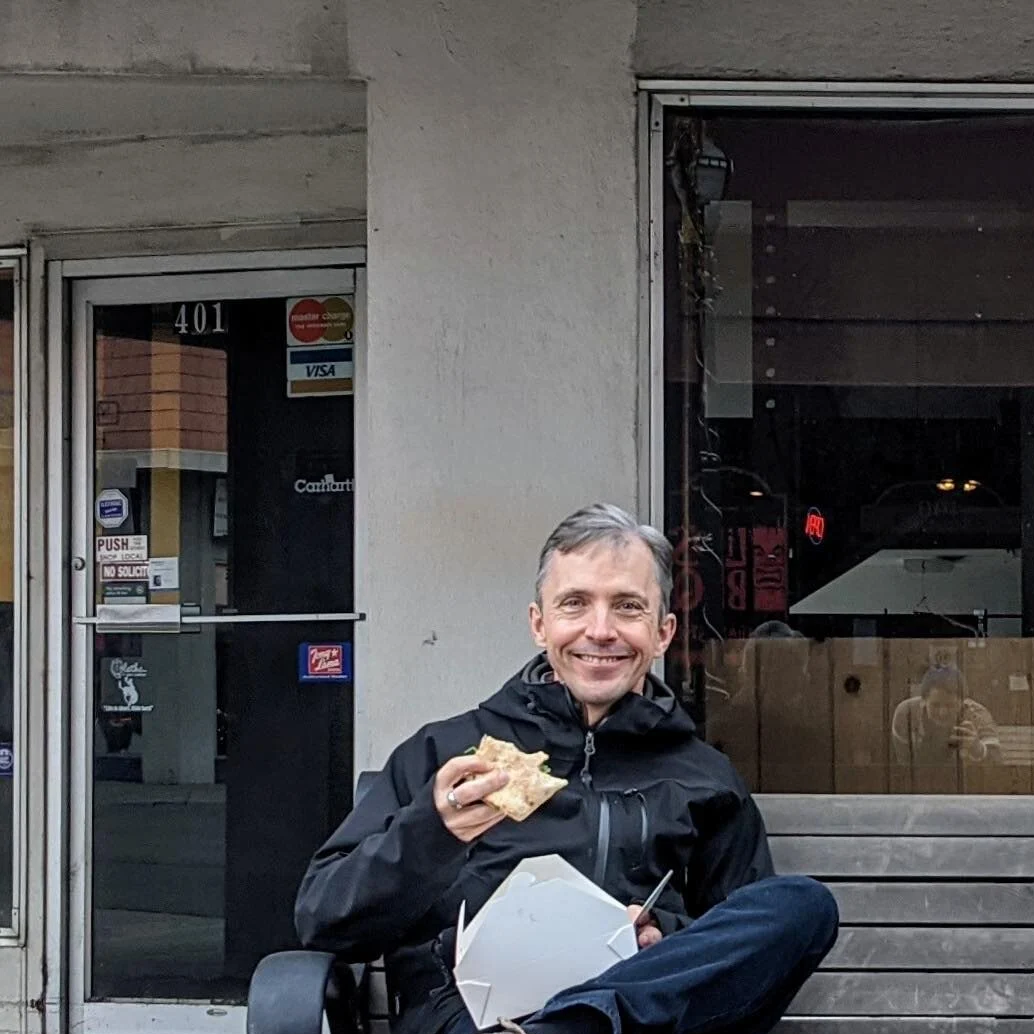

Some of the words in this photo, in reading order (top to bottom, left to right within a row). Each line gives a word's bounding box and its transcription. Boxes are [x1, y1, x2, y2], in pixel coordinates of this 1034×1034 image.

[174, 302, 226, 334] 401
[305, 364, 336, 378] VISA
[97, 537, 129, 552] PUSH
[103, 565, 116, 578] NO
[117, 565, 149, 578] SOLICIT
